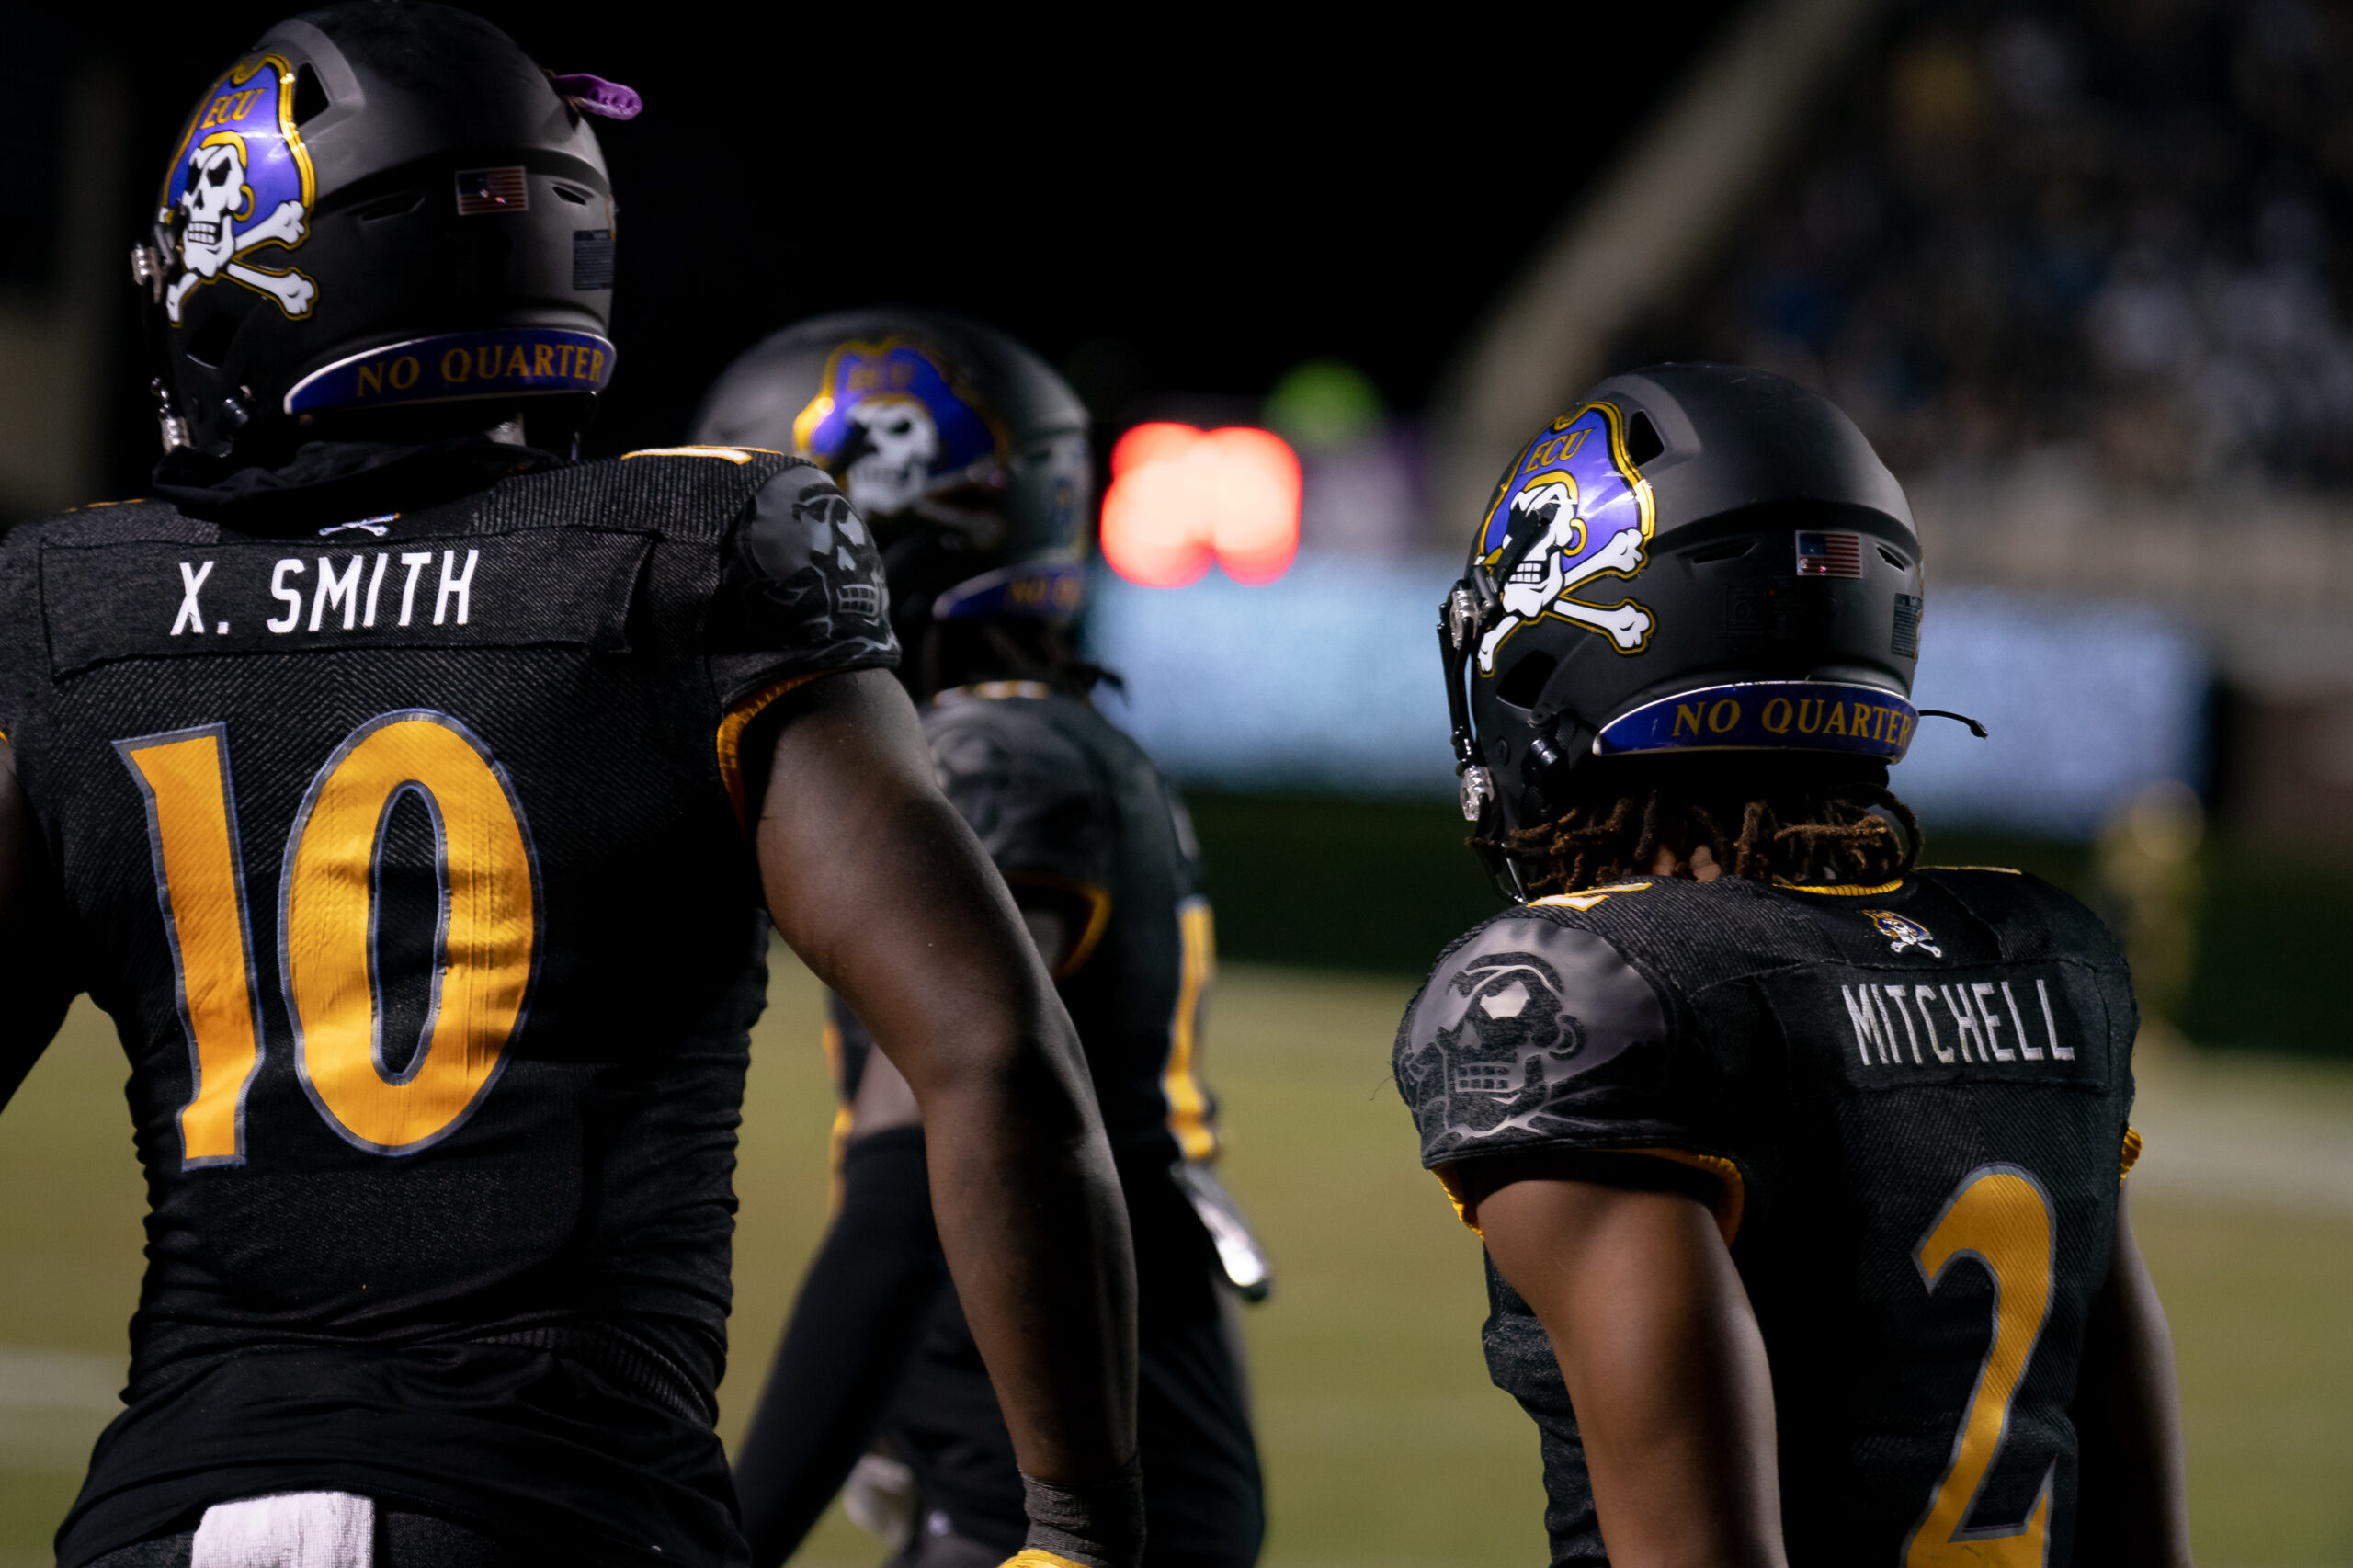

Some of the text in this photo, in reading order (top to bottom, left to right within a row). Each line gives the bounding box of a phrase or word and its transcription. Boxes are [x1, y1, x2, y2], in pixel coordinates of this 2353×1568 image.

[199, 88, 266, 130] ECU
[357, 344, 604, 398] NO QUARTER
[1522, 428, 1593, 474] ECU
[170, 550, 479, 634] X. SMITH
[1672, 698, 1913, 749] NO QUARTER
[111, 708, 544, 1171] 10
[1841, 979, 2075, 1066] MITCHELL
[1903, 1162, 2058, 1568] 2
